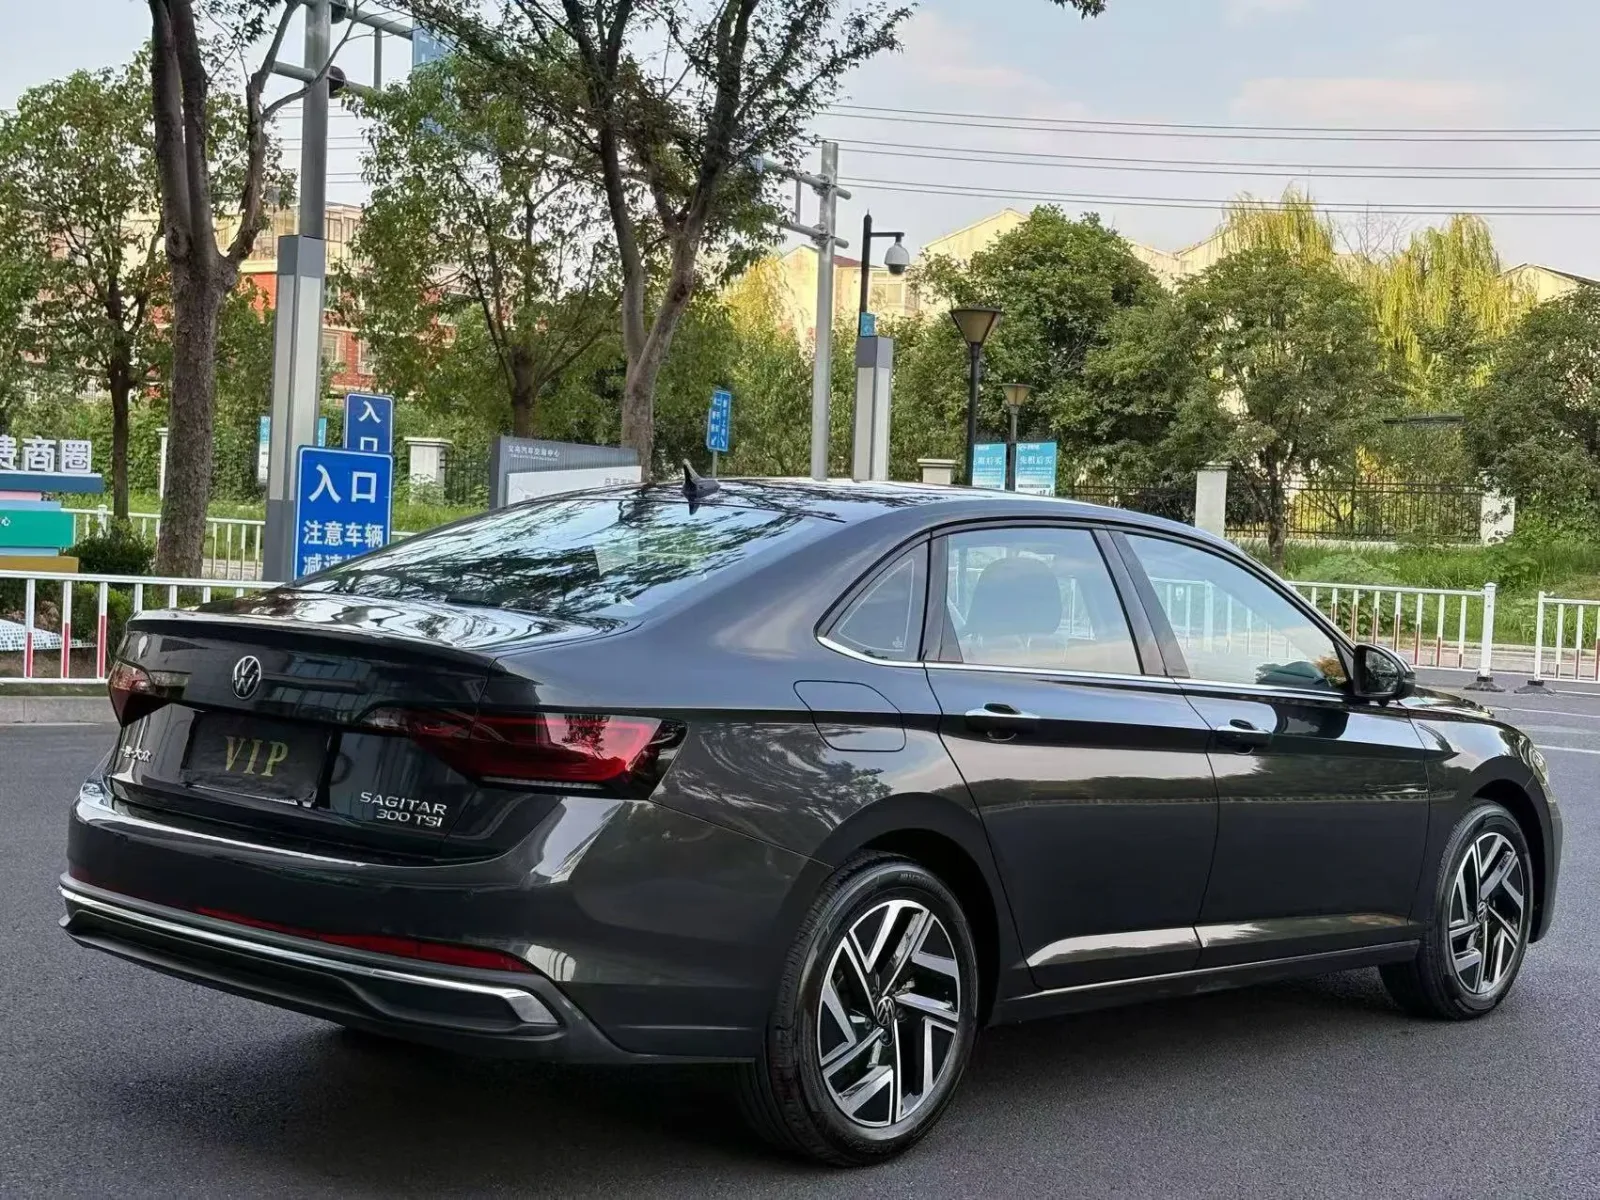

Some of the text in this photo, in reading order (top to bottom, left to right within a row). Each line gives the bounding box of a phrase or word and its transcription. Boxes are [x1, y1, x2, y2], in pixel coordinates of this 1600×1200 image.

[358, 401, 381, 451] 入口
[308, 463, 377, 503] 入口
[303, 520, 384, 548] 注意车辆
[224, 736, 289, 777] VIP
[359, 791, 448, 816] SAGITAR
[376, 808, 444, 828] 300 TSI
